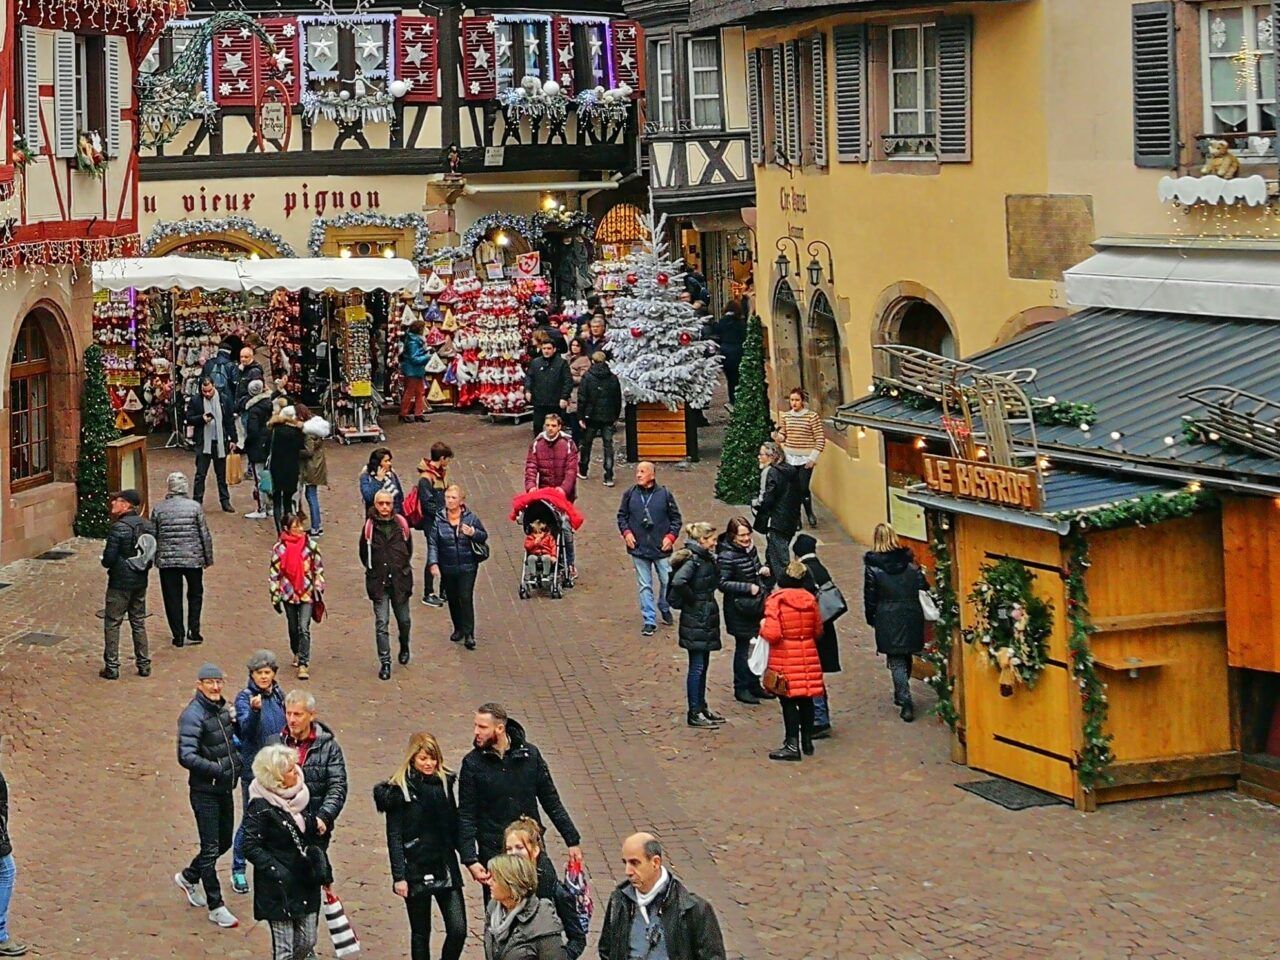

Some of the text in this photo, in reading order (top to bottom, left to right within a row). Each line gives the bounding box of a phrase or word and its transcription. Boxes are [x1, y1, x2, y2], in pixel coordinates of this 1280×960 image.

[143, 183, 380, 219] u vieux pignon
[924, 458, 1032, 509] LE BISTROT
